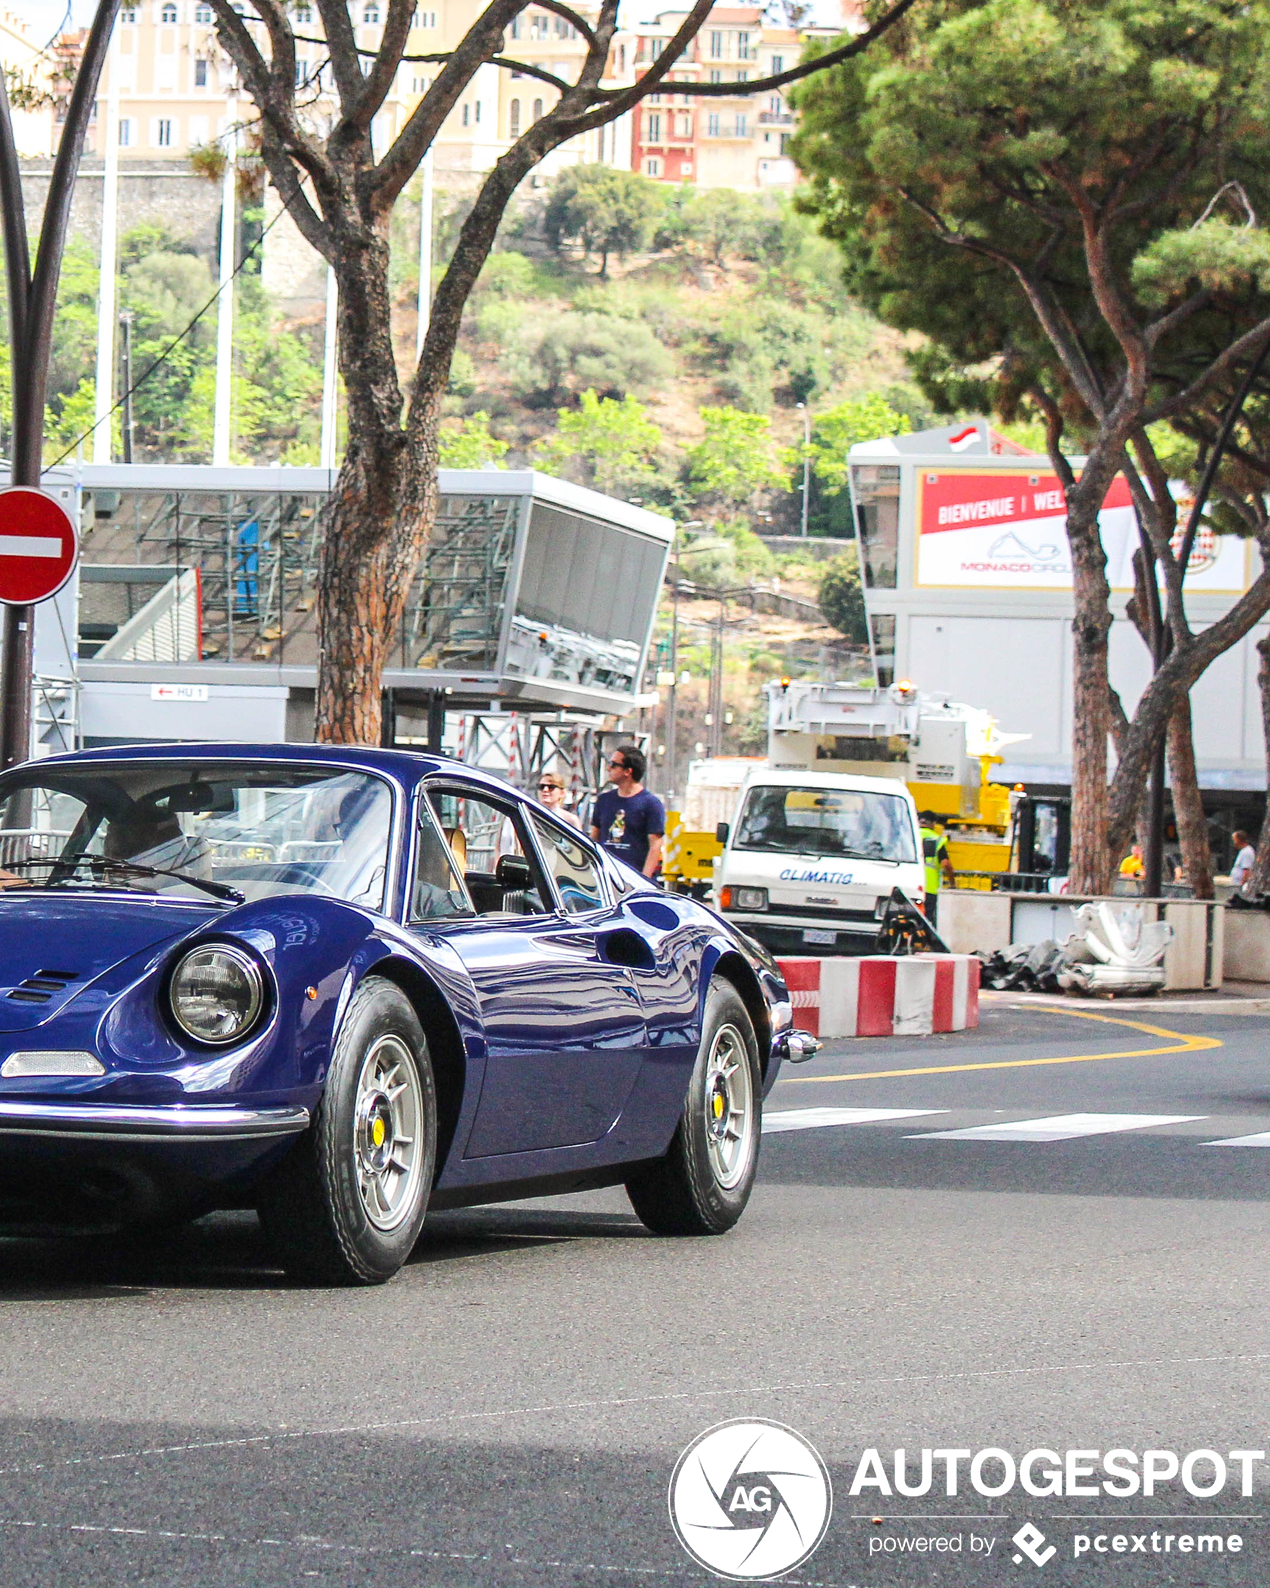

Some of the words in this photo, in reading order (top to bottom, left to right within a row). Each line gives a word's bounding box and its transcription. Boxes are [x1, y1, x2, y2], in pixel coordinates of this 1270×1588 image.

[938, 496, 1015, 525] BIENVENUE
[1033, 490, 1064, 511] WEL
[177, 687, 193, 697] HU
[198, 688, 203, 697] 1
